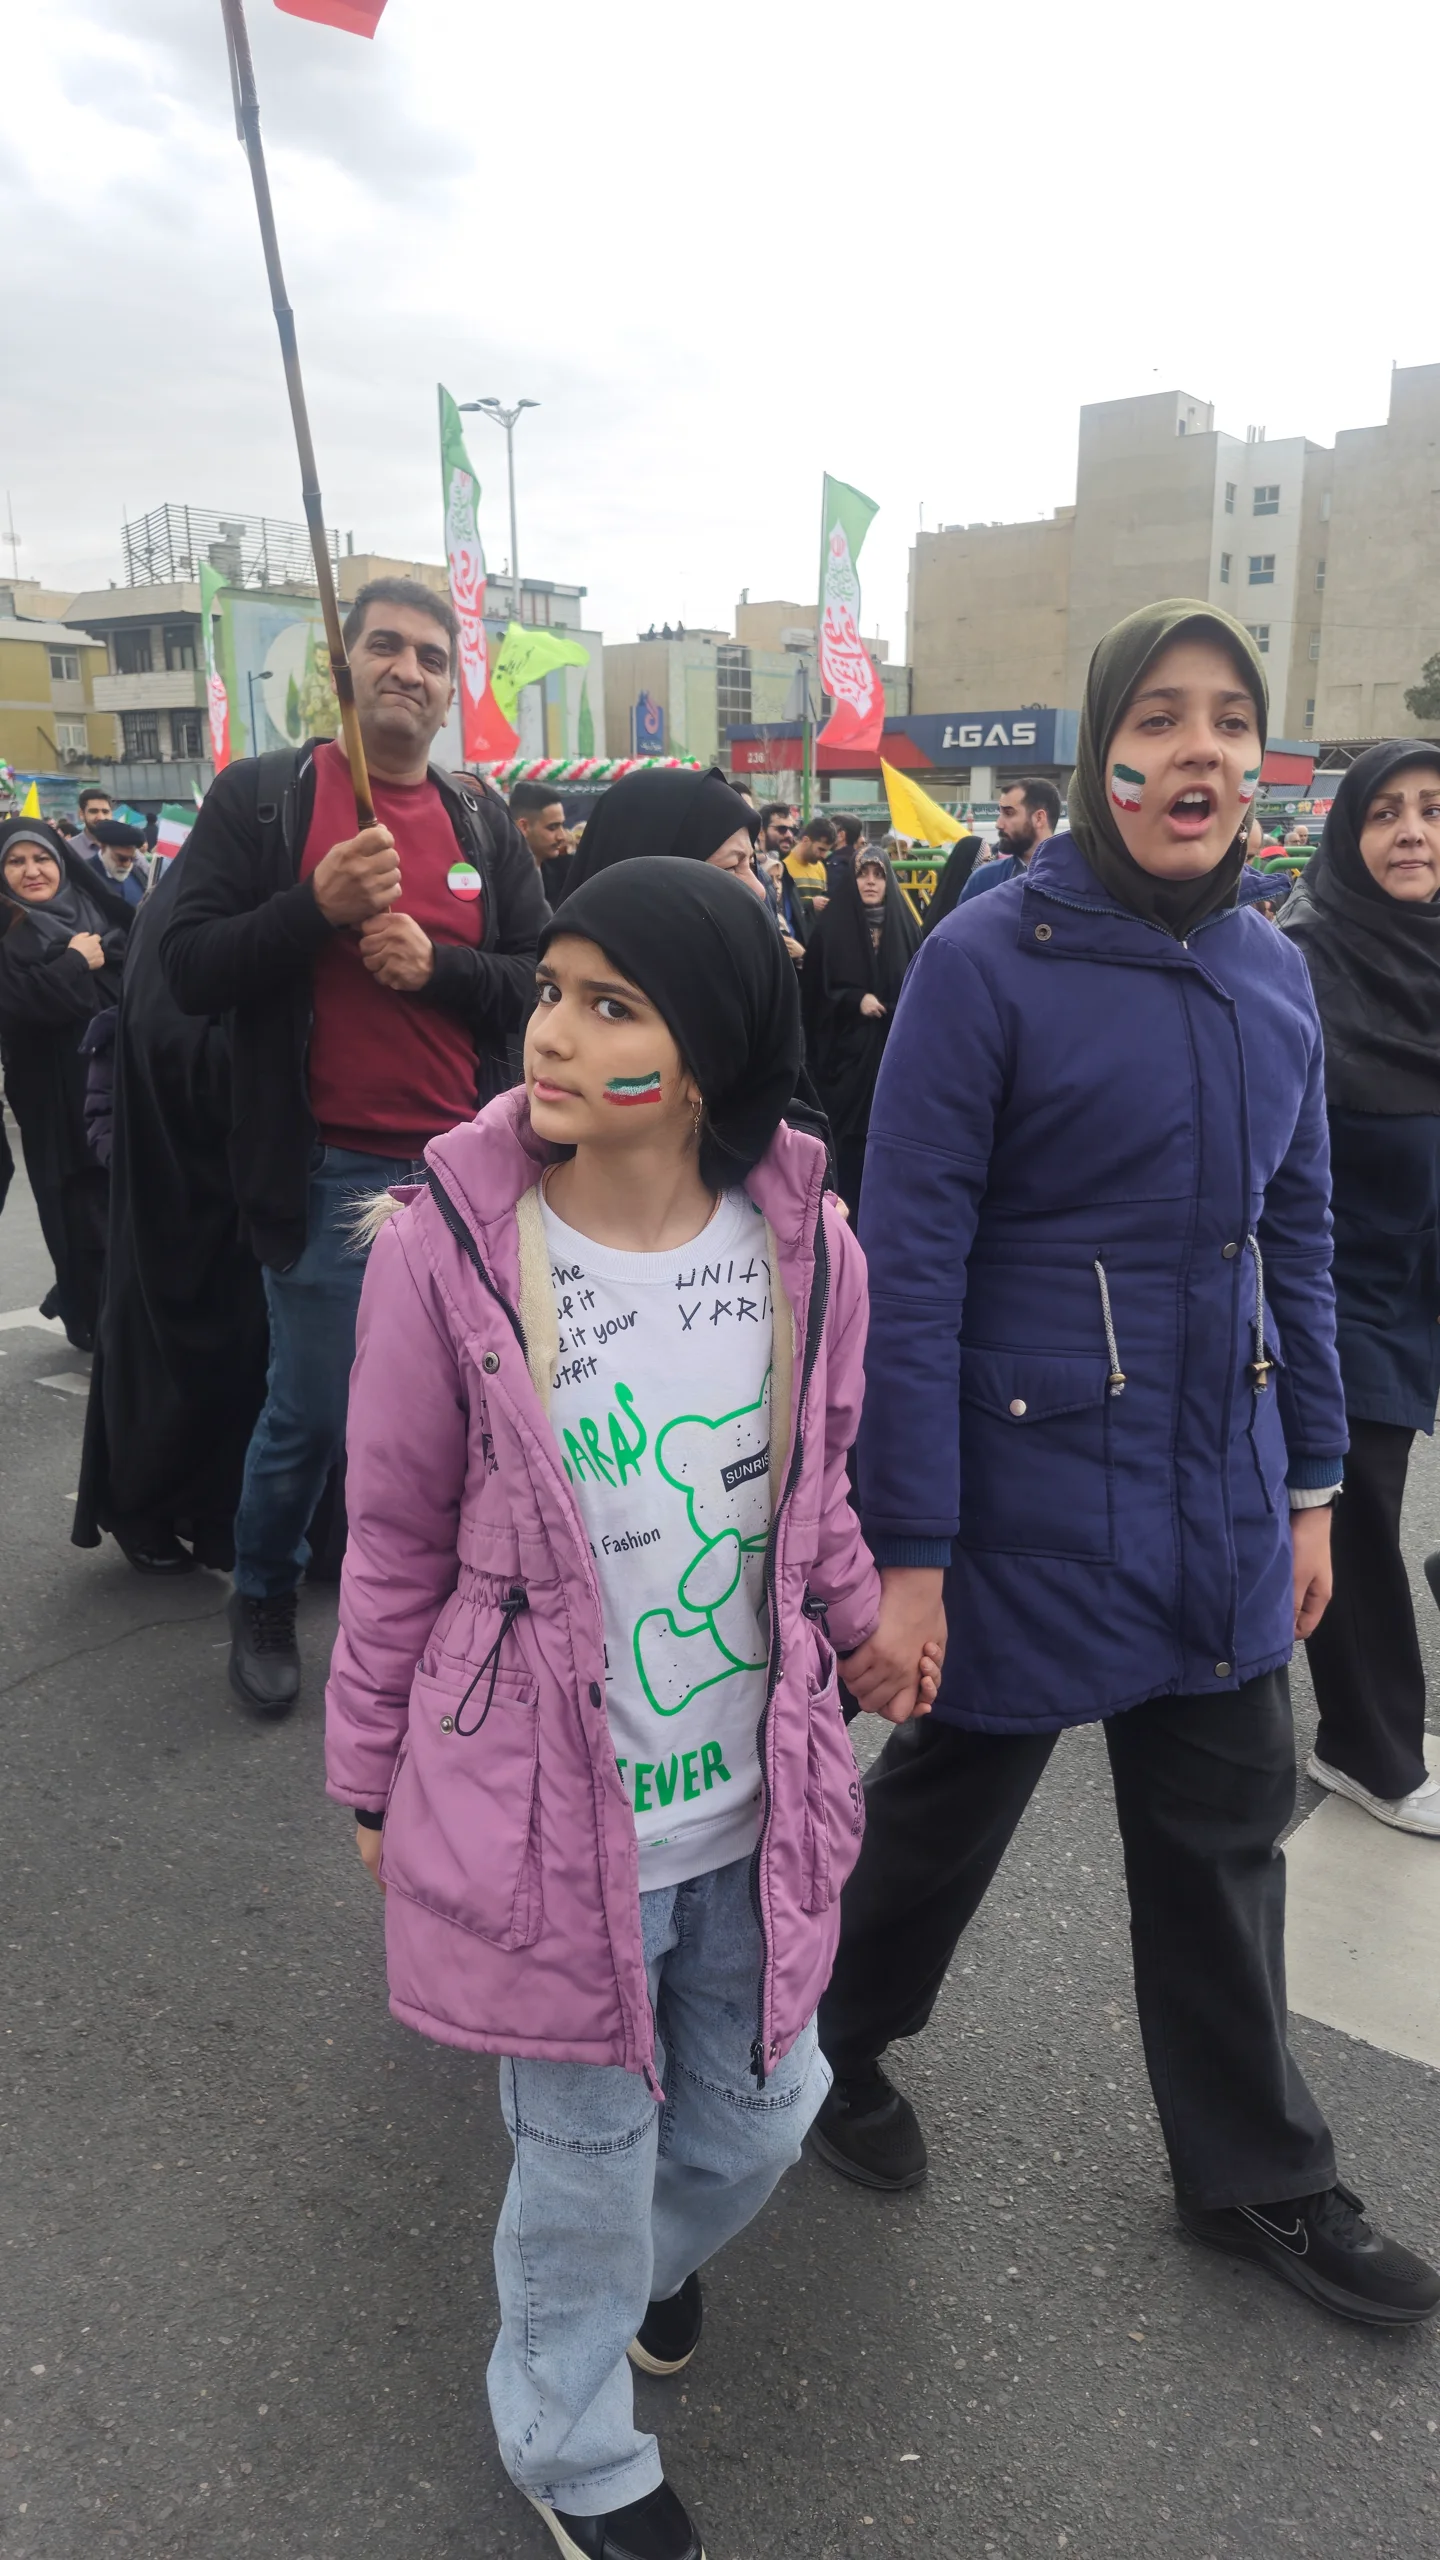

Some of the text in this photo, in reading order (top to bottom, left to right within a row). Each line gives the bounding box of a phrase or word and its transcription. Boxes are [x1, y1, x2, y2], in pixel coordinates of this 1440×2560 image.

[577, 1289, 595, 1311] it
[569, 1327, 586, 1348] it
[593, 1310, 638, 1345] your
[562, 1382, 648, 1488] ARAS
[601, 1528, 661, 1556] Fashion
